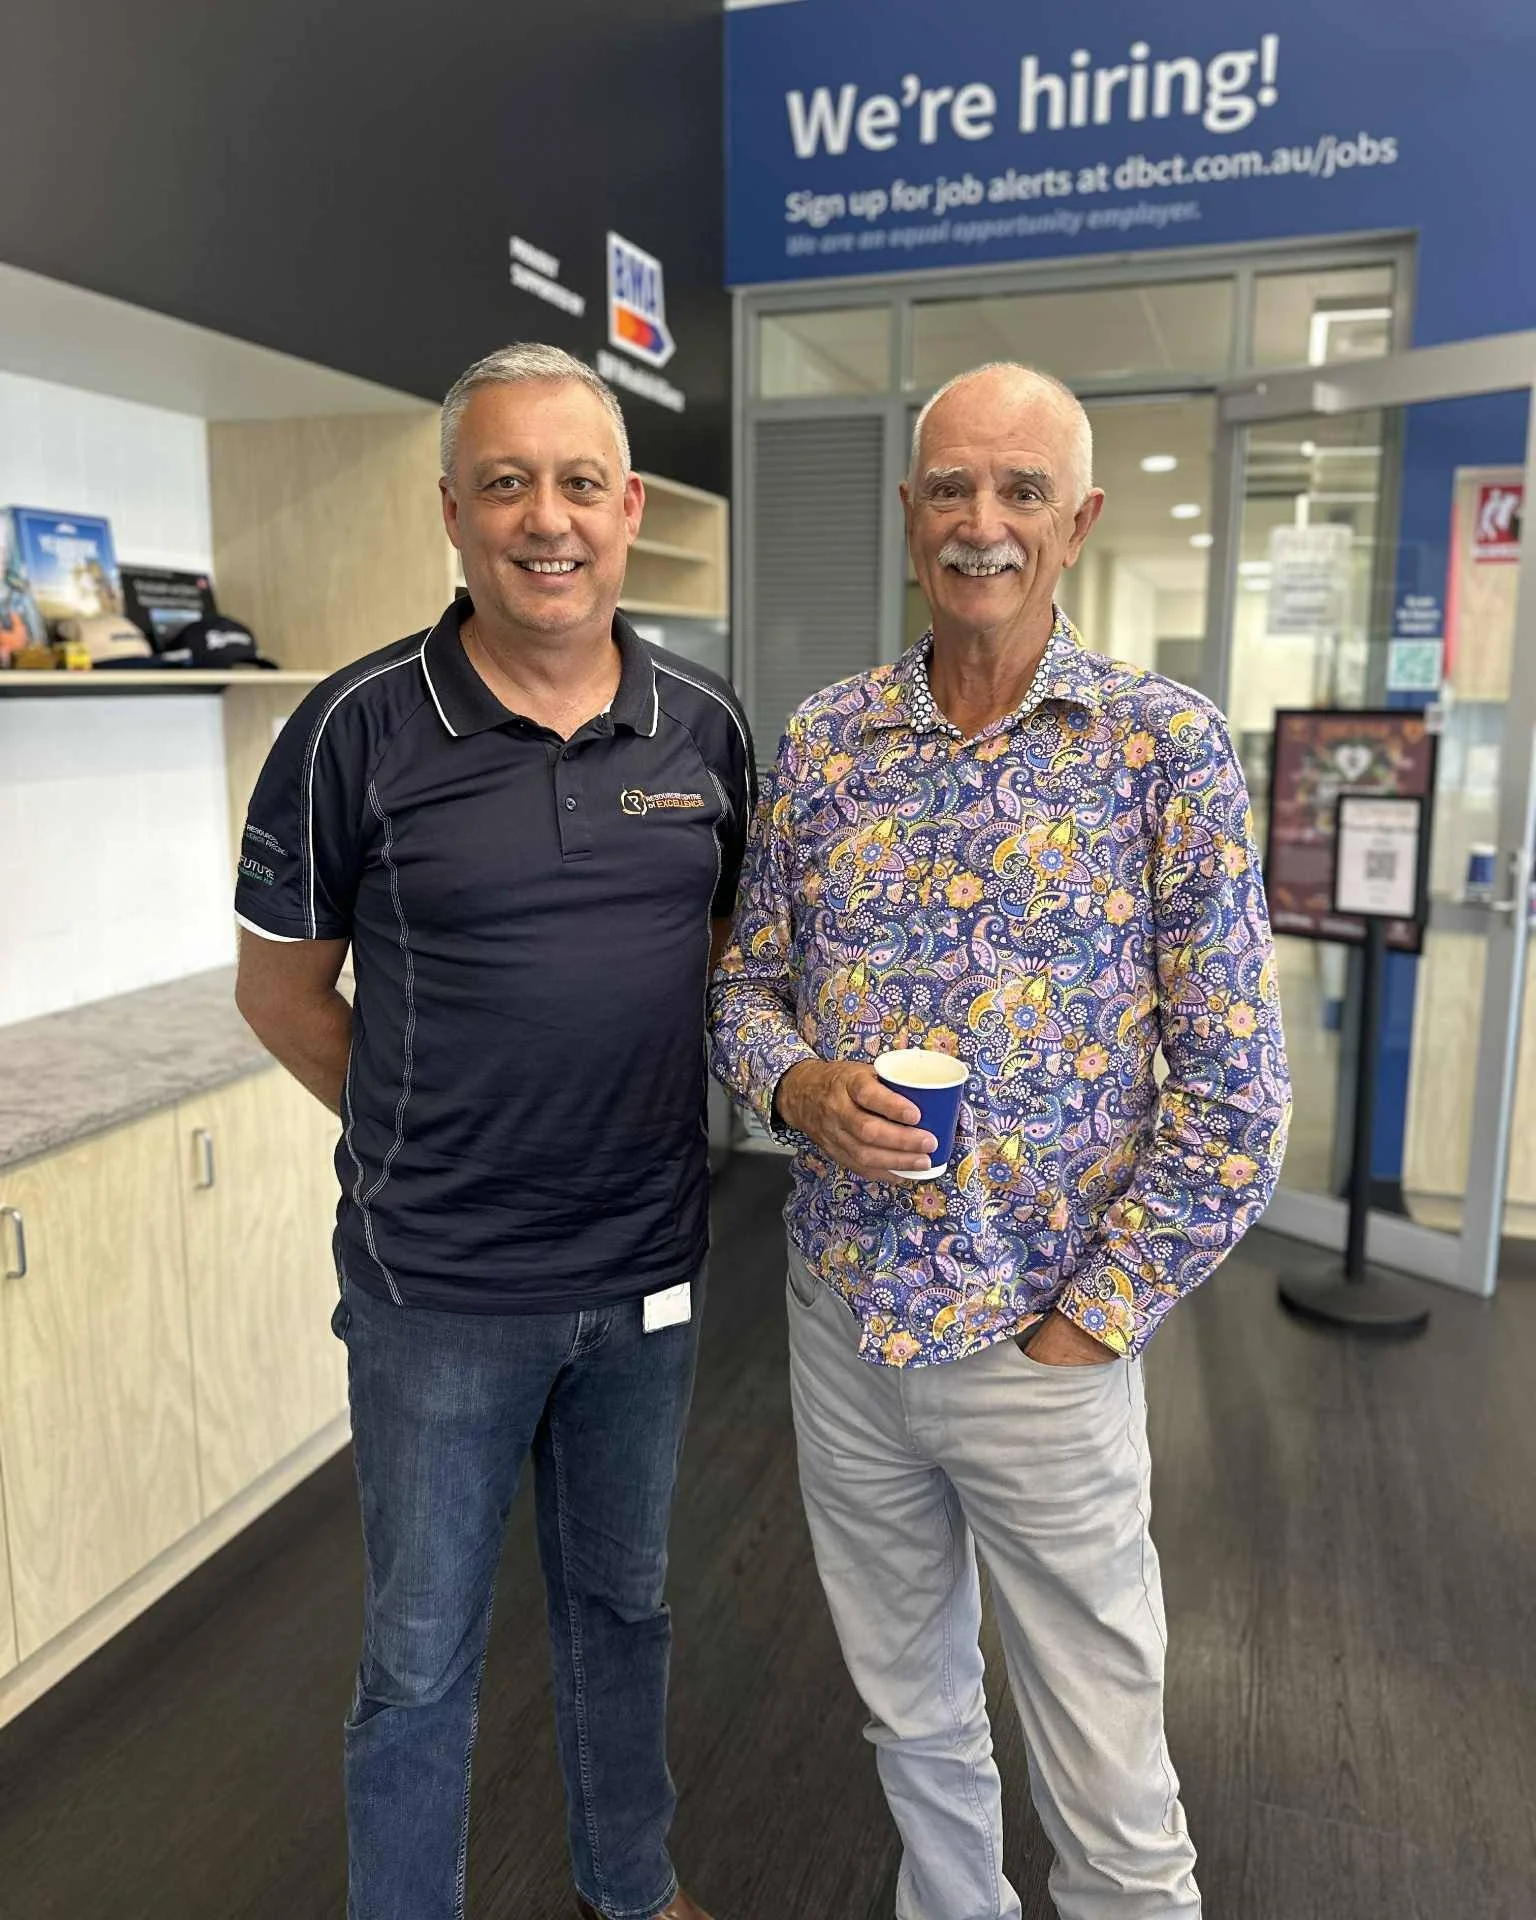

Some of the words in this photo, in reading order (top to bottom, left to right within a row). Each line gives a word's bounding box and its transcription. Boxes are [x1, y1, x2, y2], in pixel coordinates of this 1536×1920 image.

[785, 73, 997, 159] We're
[1018, 33, 1280, 134] hiring!
[785, 190, 846, 228] Sign
[849, 188, 888, 221] up
[890, 178, 933, 212] for
[934, 173, 984, 216] job
[987, 168, 1072, 203] alerts
[1076, 163, 1110, 194] at
[1113, 132, 1399, 189] dbct.com.au/jobs
[952, 207, 1080, 246] opportunity
[656, 800, 705, 808] EXCELLENCE
